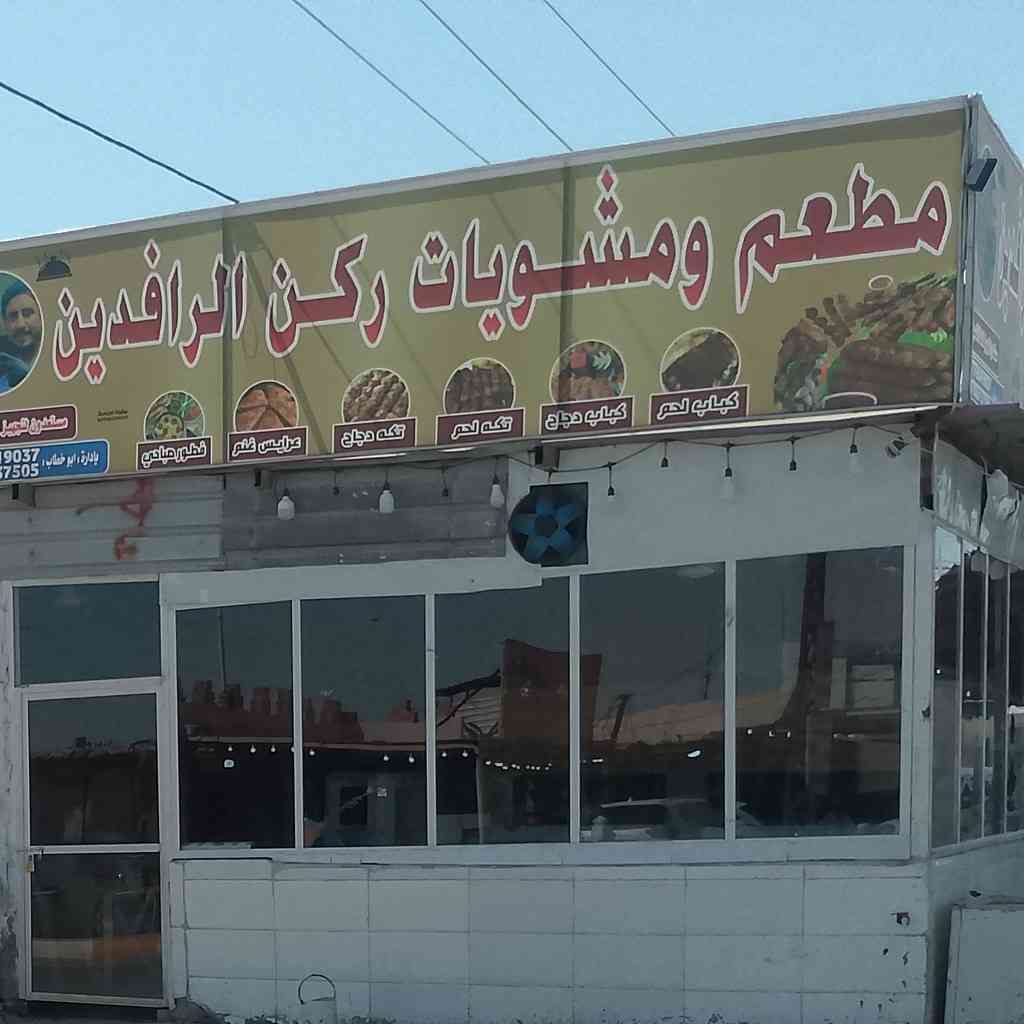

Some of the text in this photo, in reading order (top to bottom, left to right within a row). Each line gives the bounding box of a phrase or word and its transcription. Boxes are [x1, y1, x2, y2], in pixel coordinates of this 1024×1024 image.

[735, 162, 953, 313] مطعم
[410, 164, 714, 341] ومشويات
[265, 234, 386, 358] ركن
[53, 239, 247, 385] الرافدين
[545, 402, 627, 431] كباب دجاج
[657, 391, 739, 420] كباب لحم
[341, 430, 374, 448] دجاج
[451, 420, 479, 440] لحم
[176, 440, 207, 463] فطور
[232, 435, 302, 457] عرايس غنم
